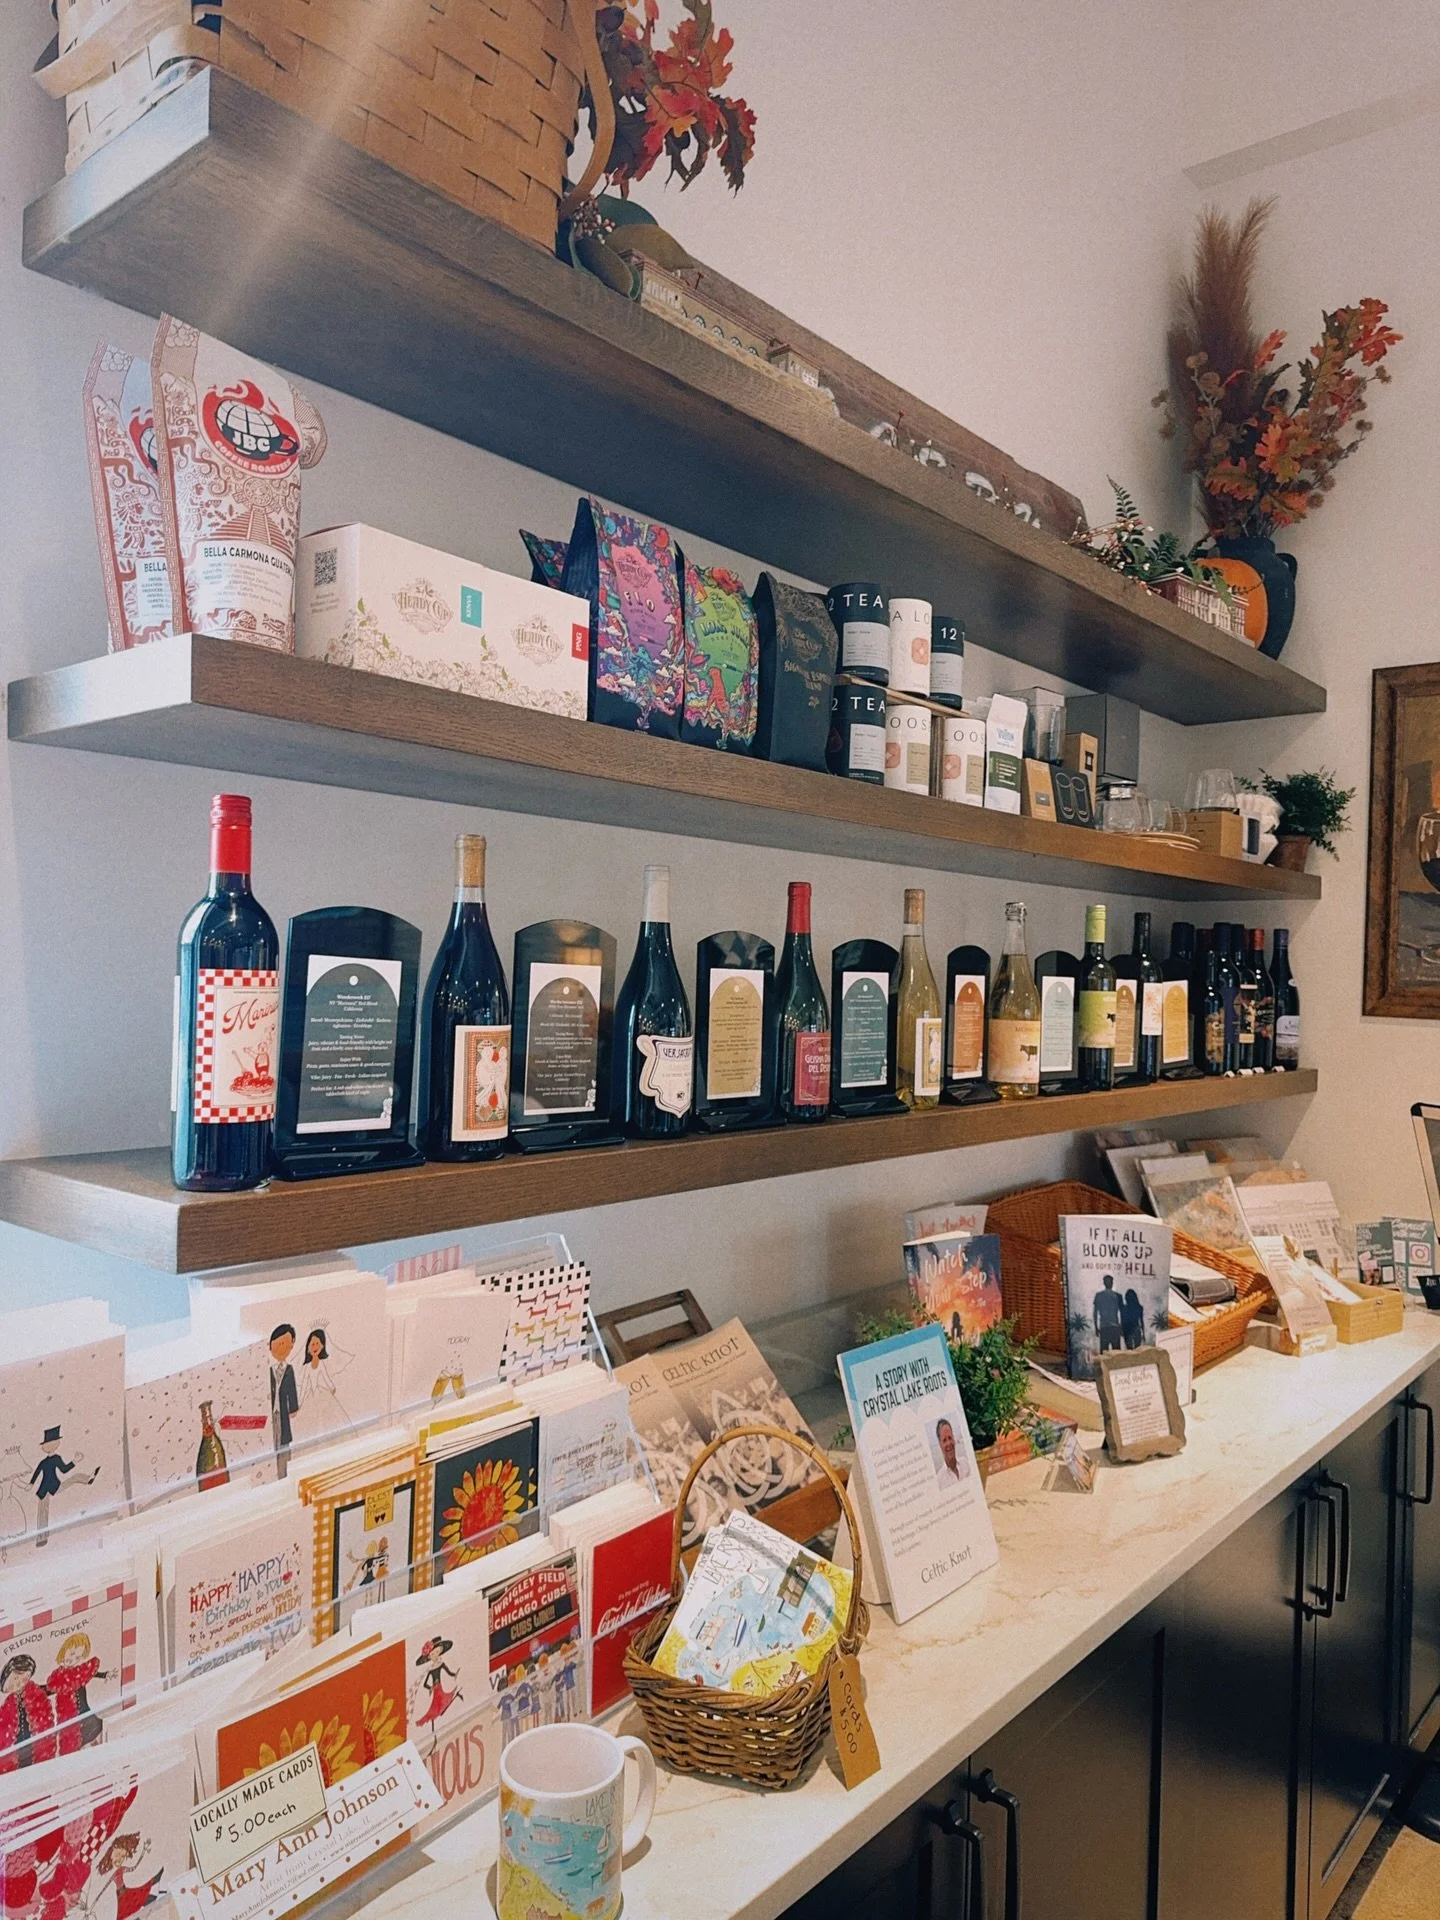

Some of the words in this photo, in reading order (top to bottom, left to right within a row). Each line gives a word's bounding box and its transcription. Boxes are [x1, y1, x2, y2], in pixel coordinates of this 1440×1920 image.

[233, 431, 271, 452] JBC
[214, 440, 250, 469] COFFEE
[204, 547, 227, 558] BELLA
[229, 547, 269, 564] CARMONA
[144, 563, 167, 572] BELLA
[400, 592, 430, 613] HEADY
[843, 593, 883, 609] TEA
[517, 629, 544, 646] HEADY
[941, 627, 957, 641] 12
[851, 697, 886, 713] TEA
[890, 717, 927, 730] OOS
[1089, 1228, 1100, 1241] IF
[1106, 1228, 1118, 1241] IT
[1123, 1230, 1146, 1243] ALL
[1083, 1244, 1128, 1259] BLOWS
[1135, 1247, 1153, 1260] UP
[1125, 1262, 1155, 1276] HELL
[701, 1337, 738, 1366] KNOT
[627, 1374, 651, 1395] OT
[876, 1374, 882, 1391] A
[883, 1364, 908, 1388] STORY
[909, 1356, 930, 1378] WITH
[863, 1389, 901, 1417] CRYSTAL
[901, 1379, 924, 1402] LAKE
[923, 1371, 947, 1393] ROOTS
[921, 1557, 949, 1584] Celtic
[949, 1545, 972, 1568] Knot
[190, 1582, 232, 1613] HAPPY
[238, 1553, 285, 1593] HAPPY
[494, 1576, 536, 1615] WRIGLEY
[538, 1571, 566, 1587] FIELD
[514, 1592, 534, 1605] HOME
[538, 1583, 547, 1593] OF
[206, 1596, 251, 1625] Birthday
[494, 1600, 538, 1631] CHICAGO
[541, 1584, 567, 1605] CUBS
[3, 1632, 43, 1656] FRIENDS
[49, 1617, 90, 1639] FOREVER
[510, 1618, 532, 1640] CUBS
[844, 1683, 863, 1732] Cards
[431, 1724, 483, 1804] OUS
[194, 1794, 239, 1832] LOCALLY
[242, 1777, 275, 1804] MADE
[279, 1754, 314, 1784] CARDS
[267, 1802, 297, 1824] each
[209, 1857, 266, 1905] Mary
[275, 1826, 319, 1864] Ann
[324, 1774, 399, 1838] Johnson
